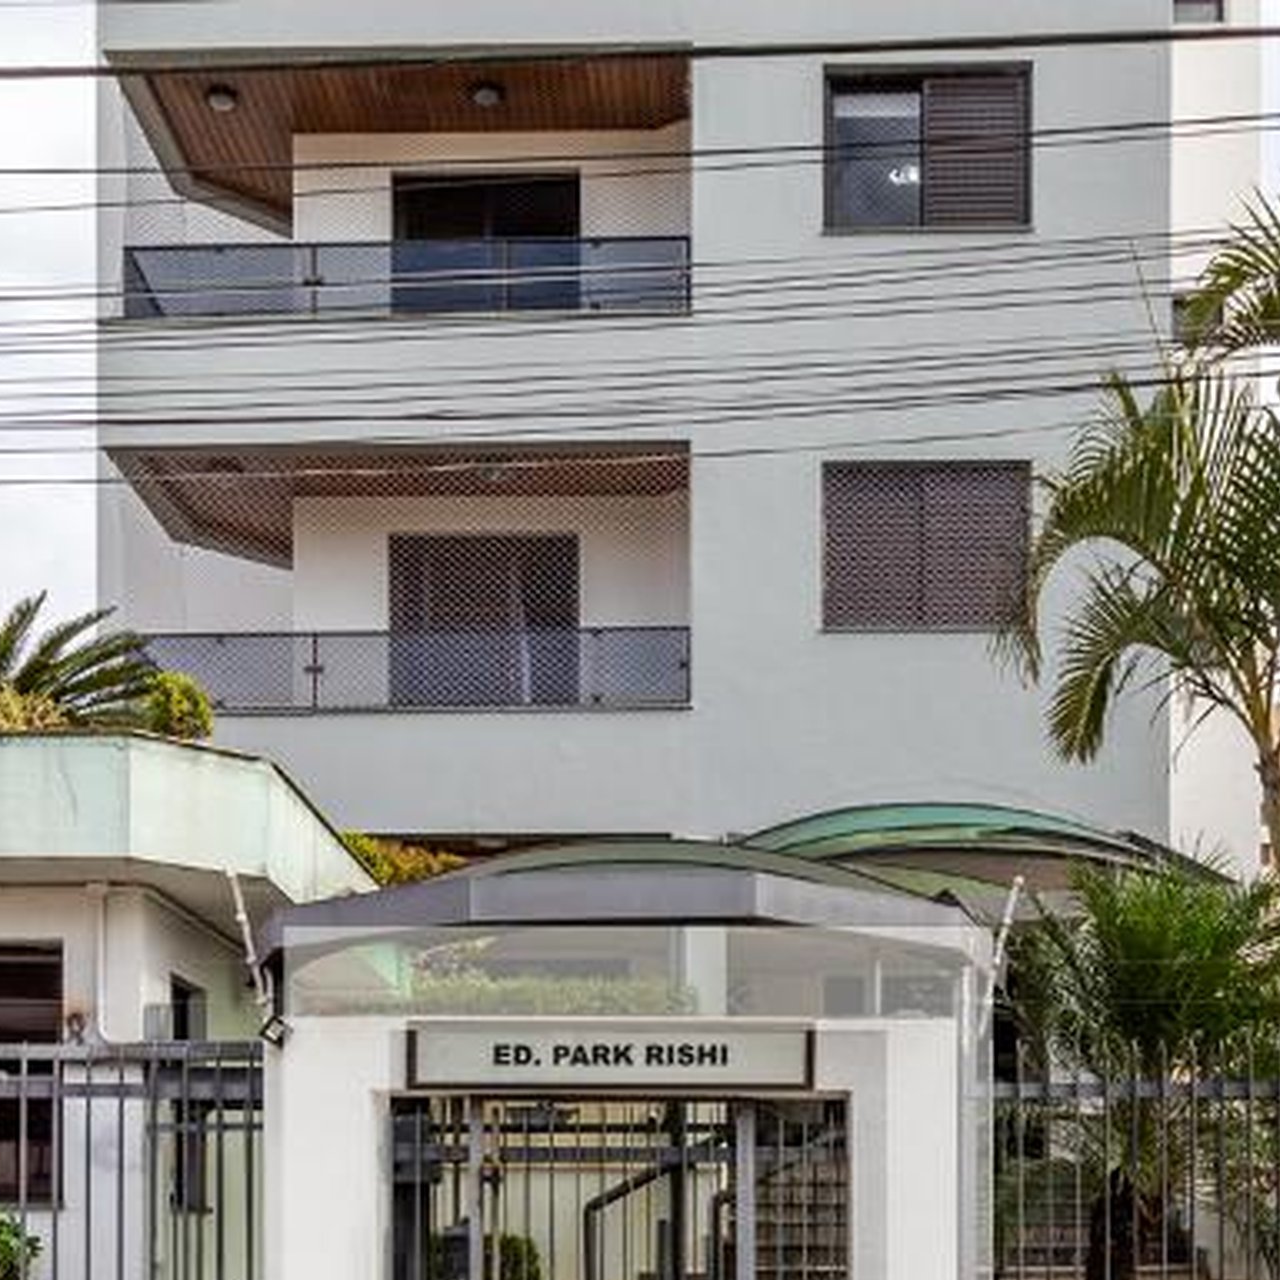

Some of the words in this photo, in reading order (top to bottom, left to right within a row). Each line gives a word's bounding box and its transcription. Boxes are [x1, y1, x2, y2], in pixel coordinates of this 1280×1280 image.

[493, 1044, 541, 1066] ED.
[553, 1044, 634, 1066] PARK
[645, 1044, 729, 1066] RISHI
